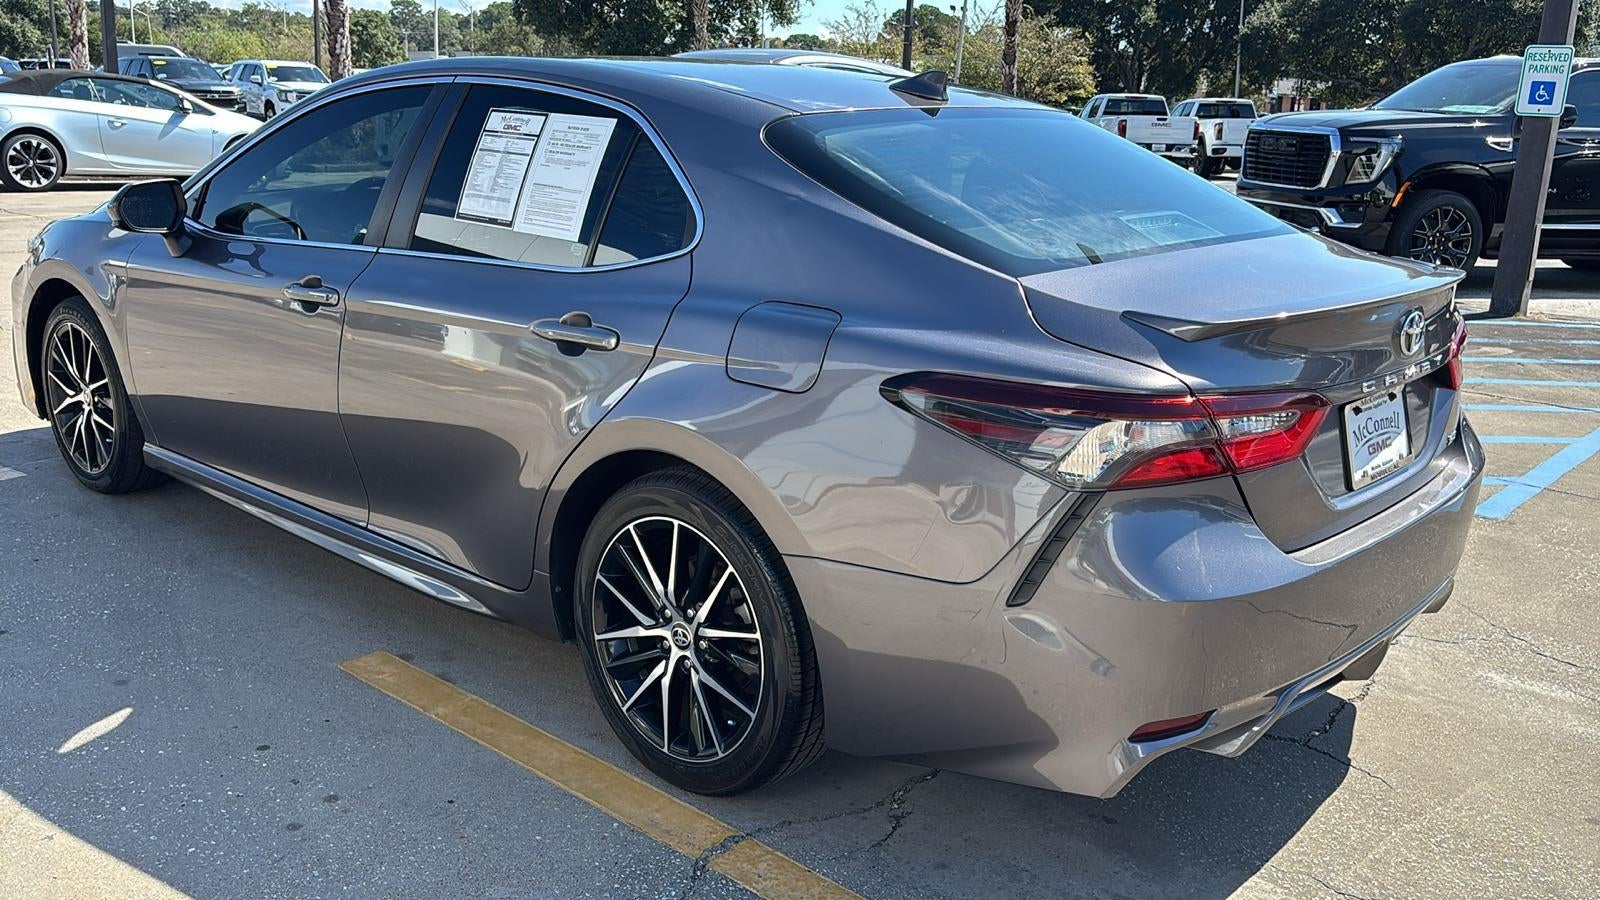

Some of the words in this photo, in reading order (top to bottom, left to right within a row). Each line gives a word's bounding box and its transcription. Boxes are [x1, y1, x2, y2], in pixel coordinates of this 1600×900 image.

[1528, 52, 1570, 62] RESERVED
[1528, 64, 1565, 74] PARKING
[503, 123, 522, 131] GMC
[1362, 354, 1443, 393] CAMRY
[1352, 411, 1400, 448] McConnell
[1367, 436, 1393, 456] GMC
